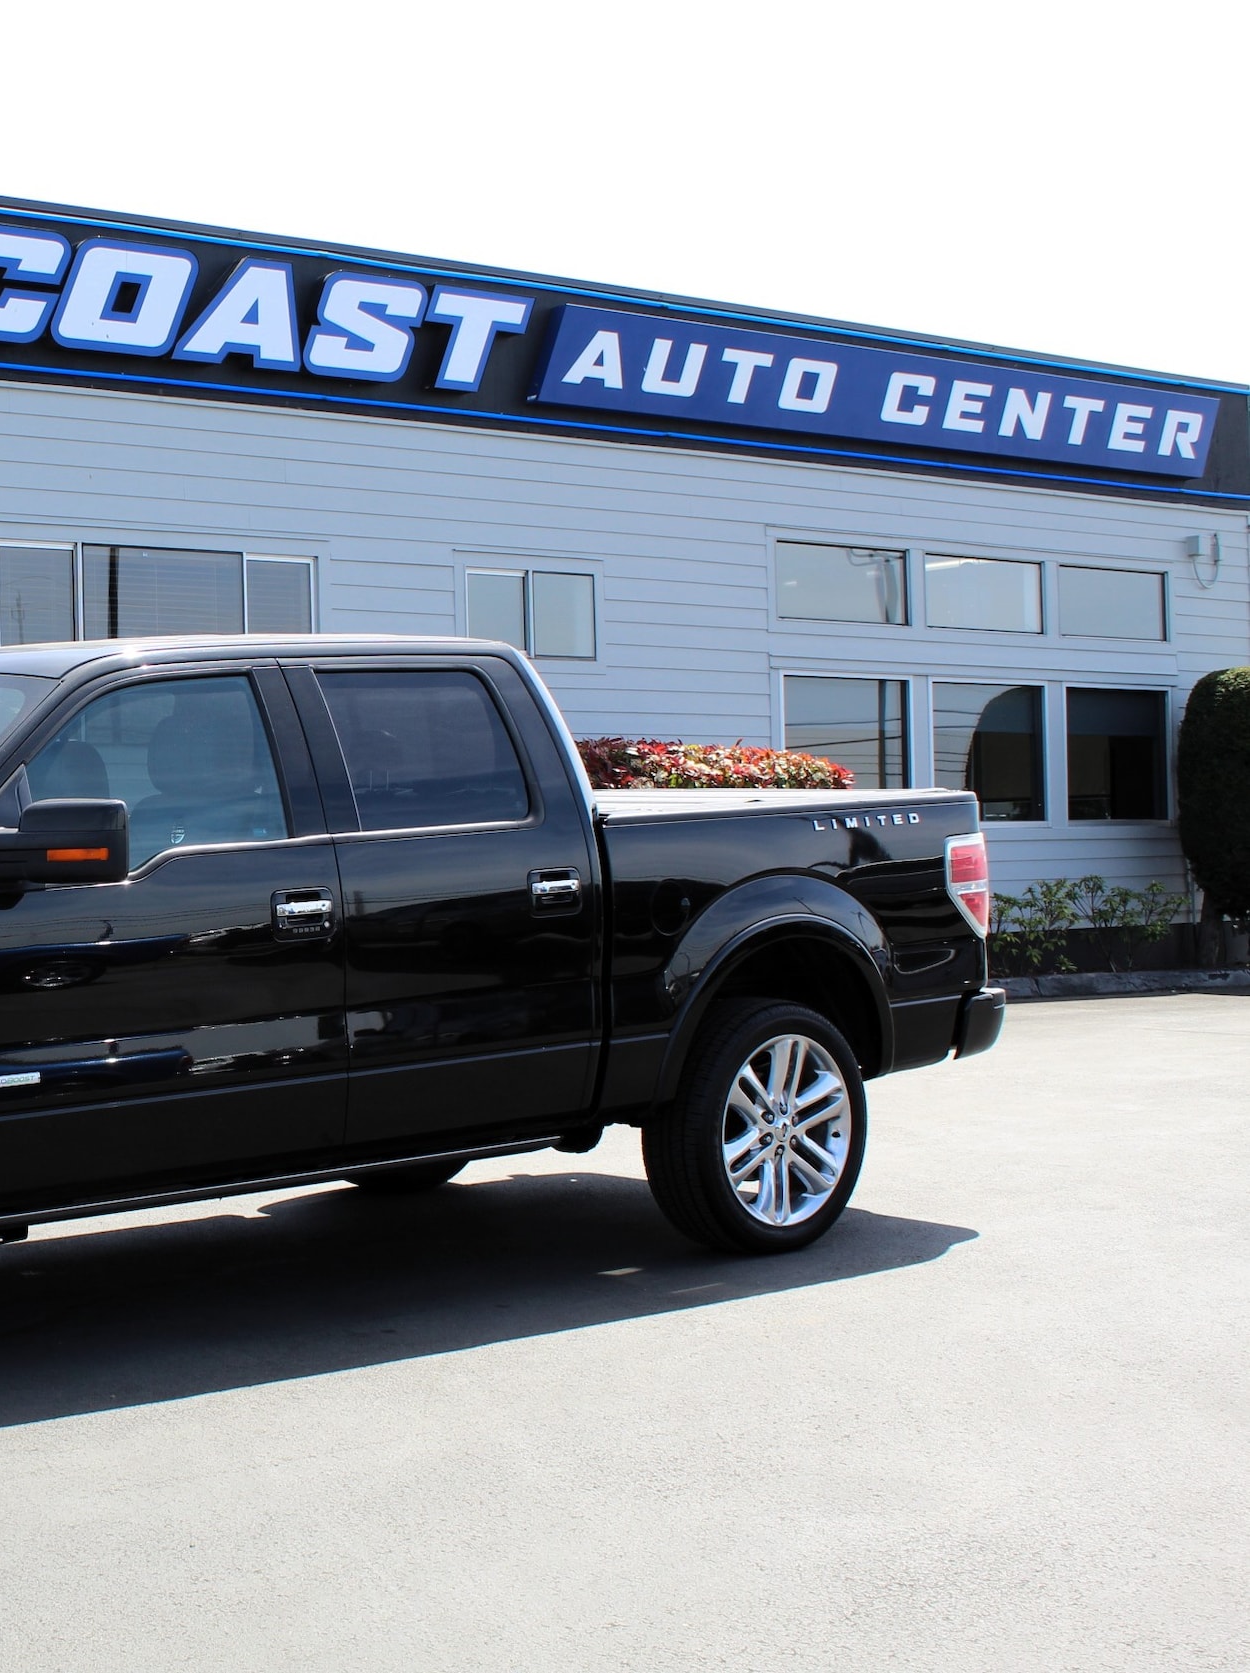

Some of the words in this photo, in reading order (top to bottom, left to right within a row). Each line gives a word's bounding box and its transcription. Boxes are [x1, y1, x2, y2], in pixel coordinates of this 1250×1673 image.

[563, 330, 838, 415] AUTO
[880, 371, 1204, 460] CENTER
[813, 812, 920, 832] LIMITED
